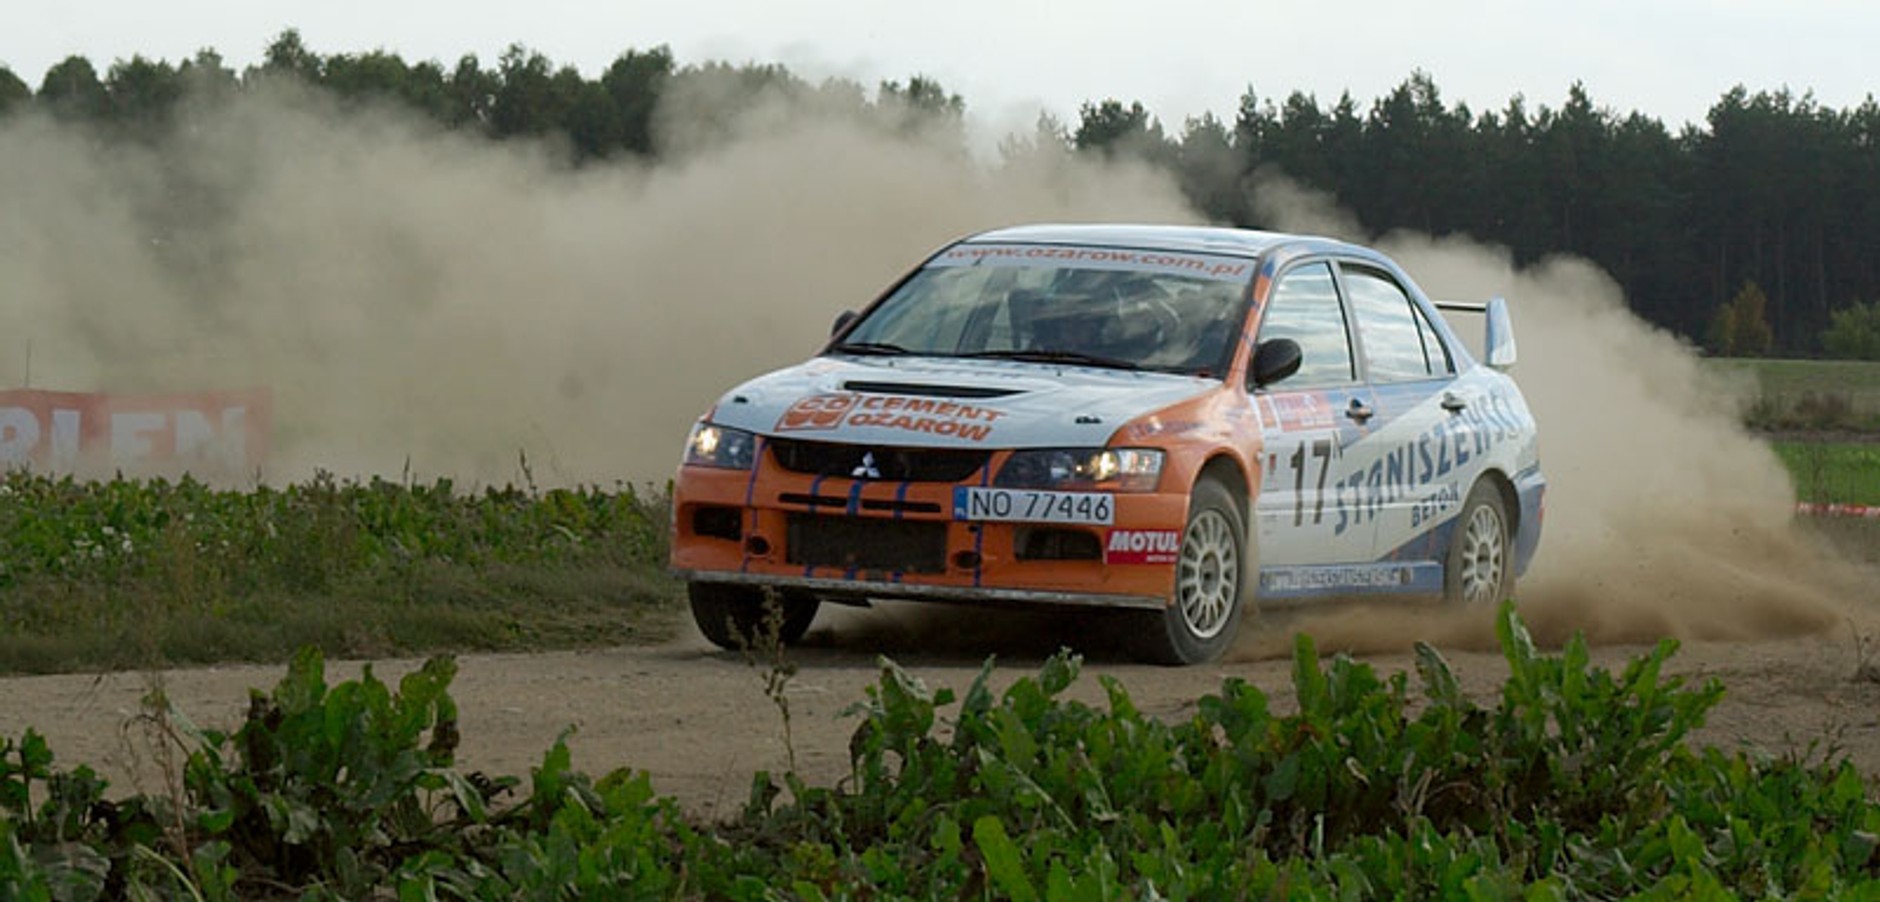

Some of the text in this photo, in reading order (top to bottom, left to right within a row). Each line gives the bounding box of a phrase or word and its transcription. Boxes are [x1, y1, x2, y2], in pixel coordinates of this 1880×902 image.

[947, 246, 1249, 277] www.ozarow.com.pl
[863, 396, 1007, 421] CEMENT
[1290, 439, 1332, 527] 17
[972, 490, 1109, 520] NO 77446
[1108, 531, 1178, 552] MOTUL
